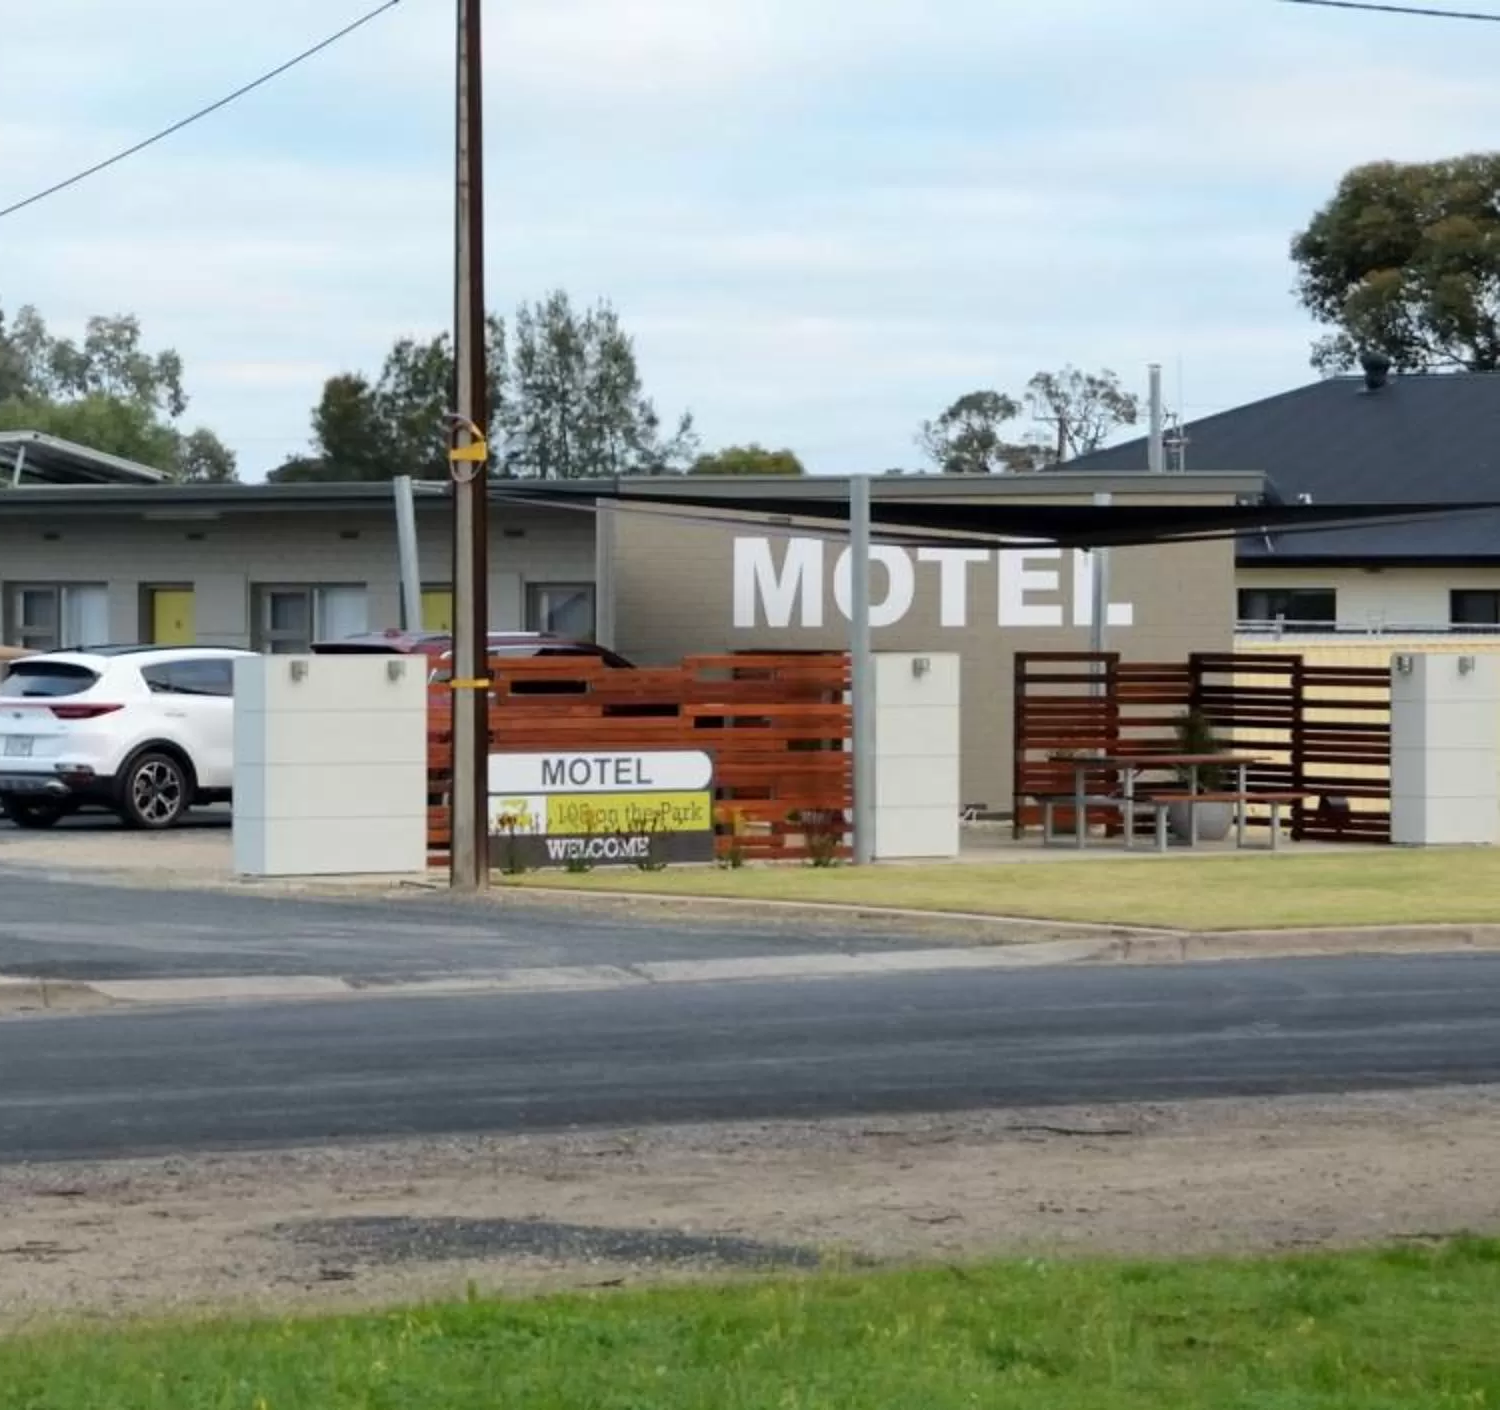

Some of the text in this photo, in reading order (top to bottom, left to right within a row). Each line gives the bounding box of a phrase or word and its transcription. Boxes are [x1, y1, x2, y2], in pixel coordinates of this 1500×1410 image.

[733, 536, 1134, 629] MOTEL
[541, 757, 653, 787] MOTEL
[596, 808, 619, 824] on
[625, 802, 654, 822] the
[660, 800, 704, 823] Park
[546, 836, 650, 861] WELCOME
